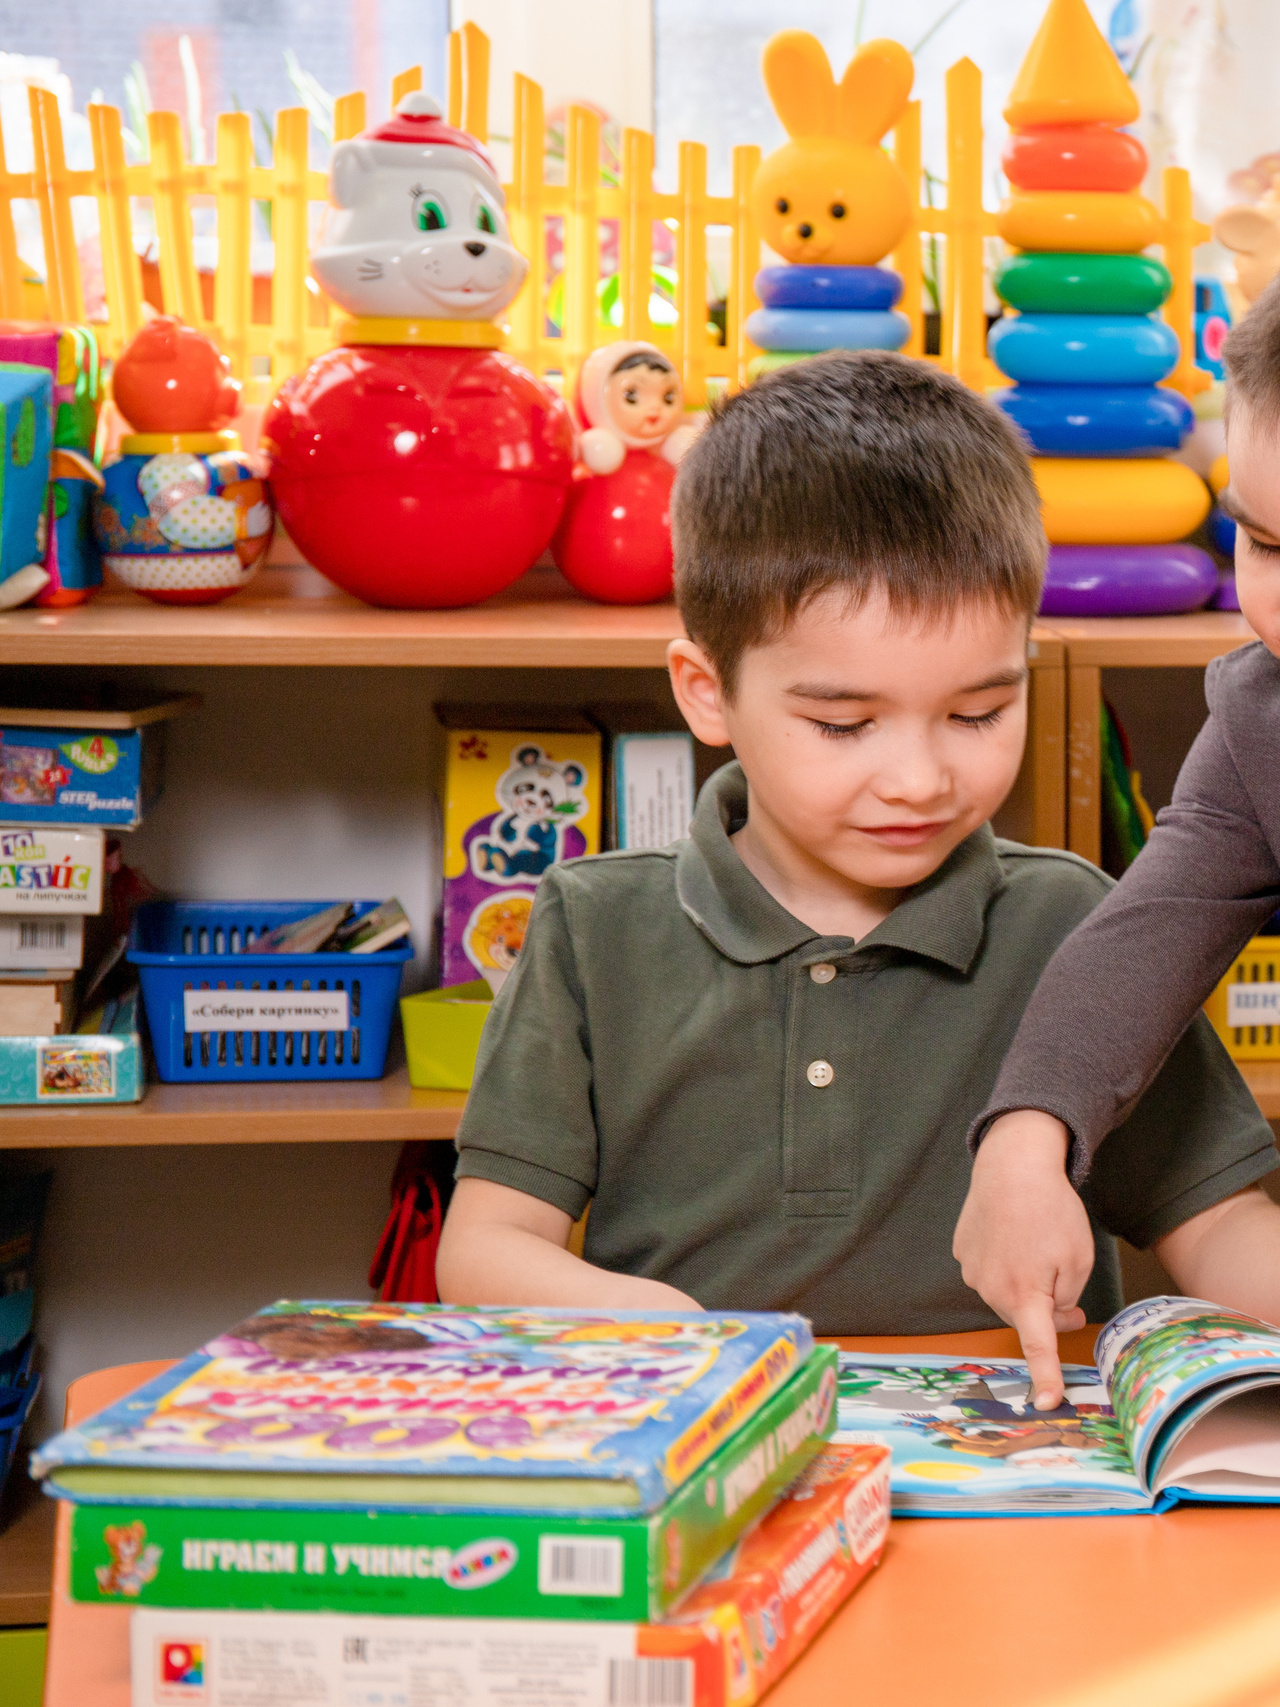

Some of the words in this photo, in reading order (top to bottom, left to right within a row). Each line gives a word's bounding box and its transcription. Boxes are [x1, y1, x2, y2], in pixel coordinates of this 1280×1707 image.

[88, 735, 104, 759] 4
[59, 791, 97, 805] STEP
[88, 797, 134, 811] puzzle
[0, 855, 87, 888] ASTÍC
[16, 892, 29, 900] на
[33, 892, 87, 903] липучках
[192, 1003, 254, 1019] «Собери
[259, 1005, 339, 1020] картинку»
[182, 1538, 297, 1574] ИГРАЕМ
[303, 1541, 326, 1575] И
[331, 1543, 452, 1579] УЧИМСЯ
